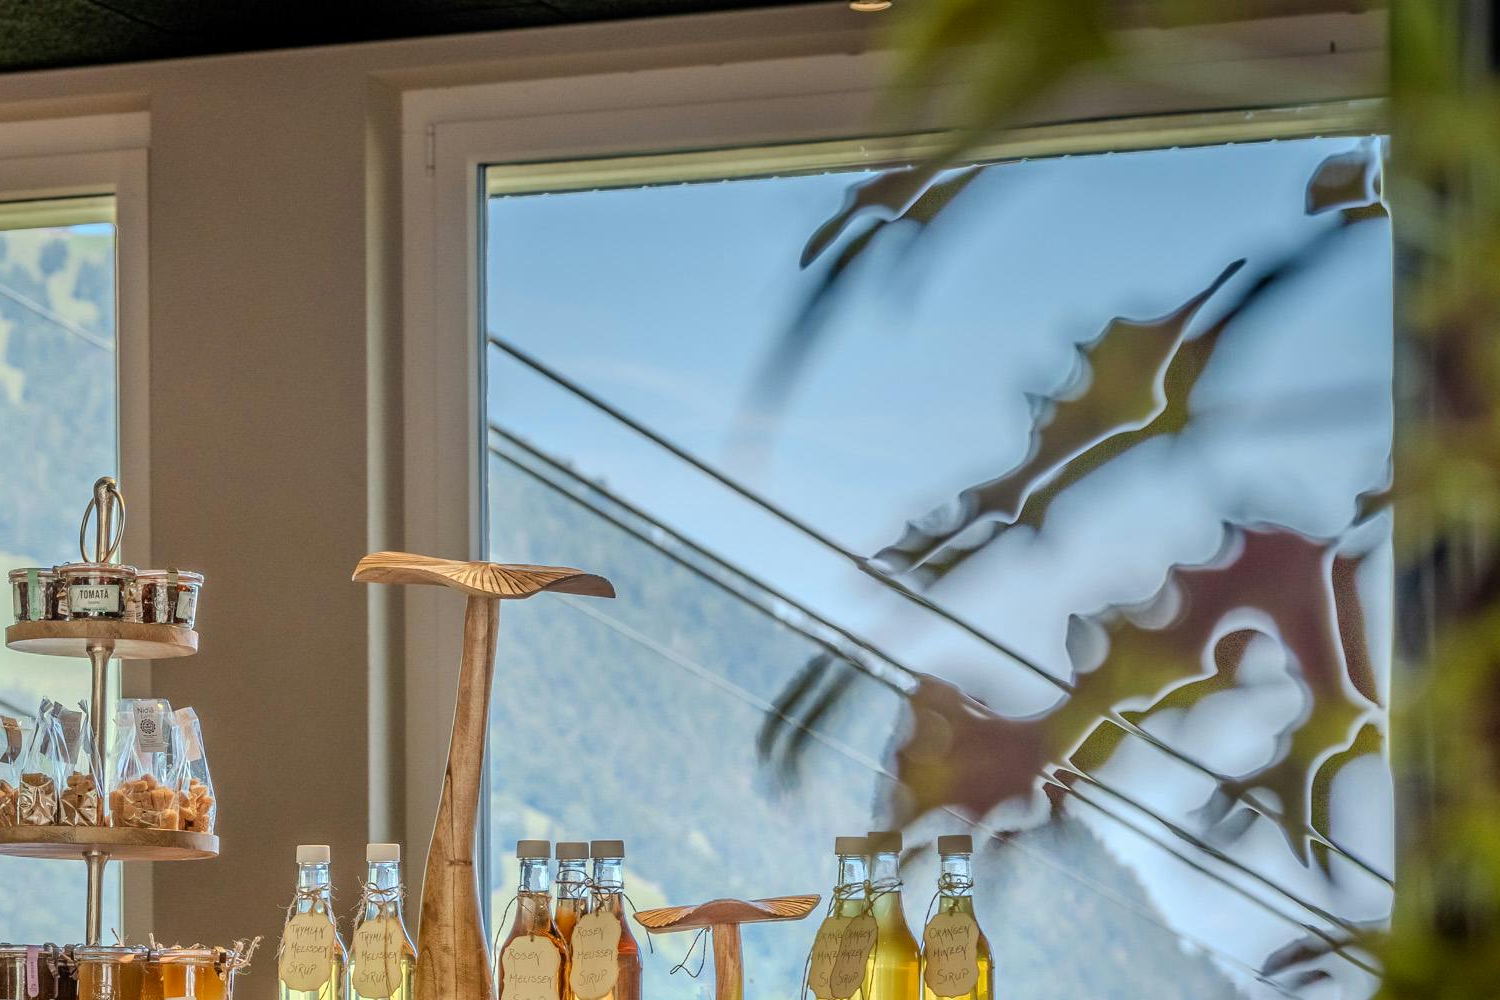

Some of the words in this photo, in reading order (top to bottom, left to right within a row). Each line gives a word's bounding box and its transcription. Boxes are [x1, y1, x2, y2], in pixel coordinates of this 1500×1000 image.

[577, 926, 604, 942] ROSEN
[928, 924, 971, 943] ORANGEN
[508, 948, 541, 967] ROSEN
[287, 962, 317, 978] SIRUP
[836, 970, 859, 987] SIRUP
[936, 968, 970, 986] SIRUP
[578, 969, 608, 991] SIRUP
